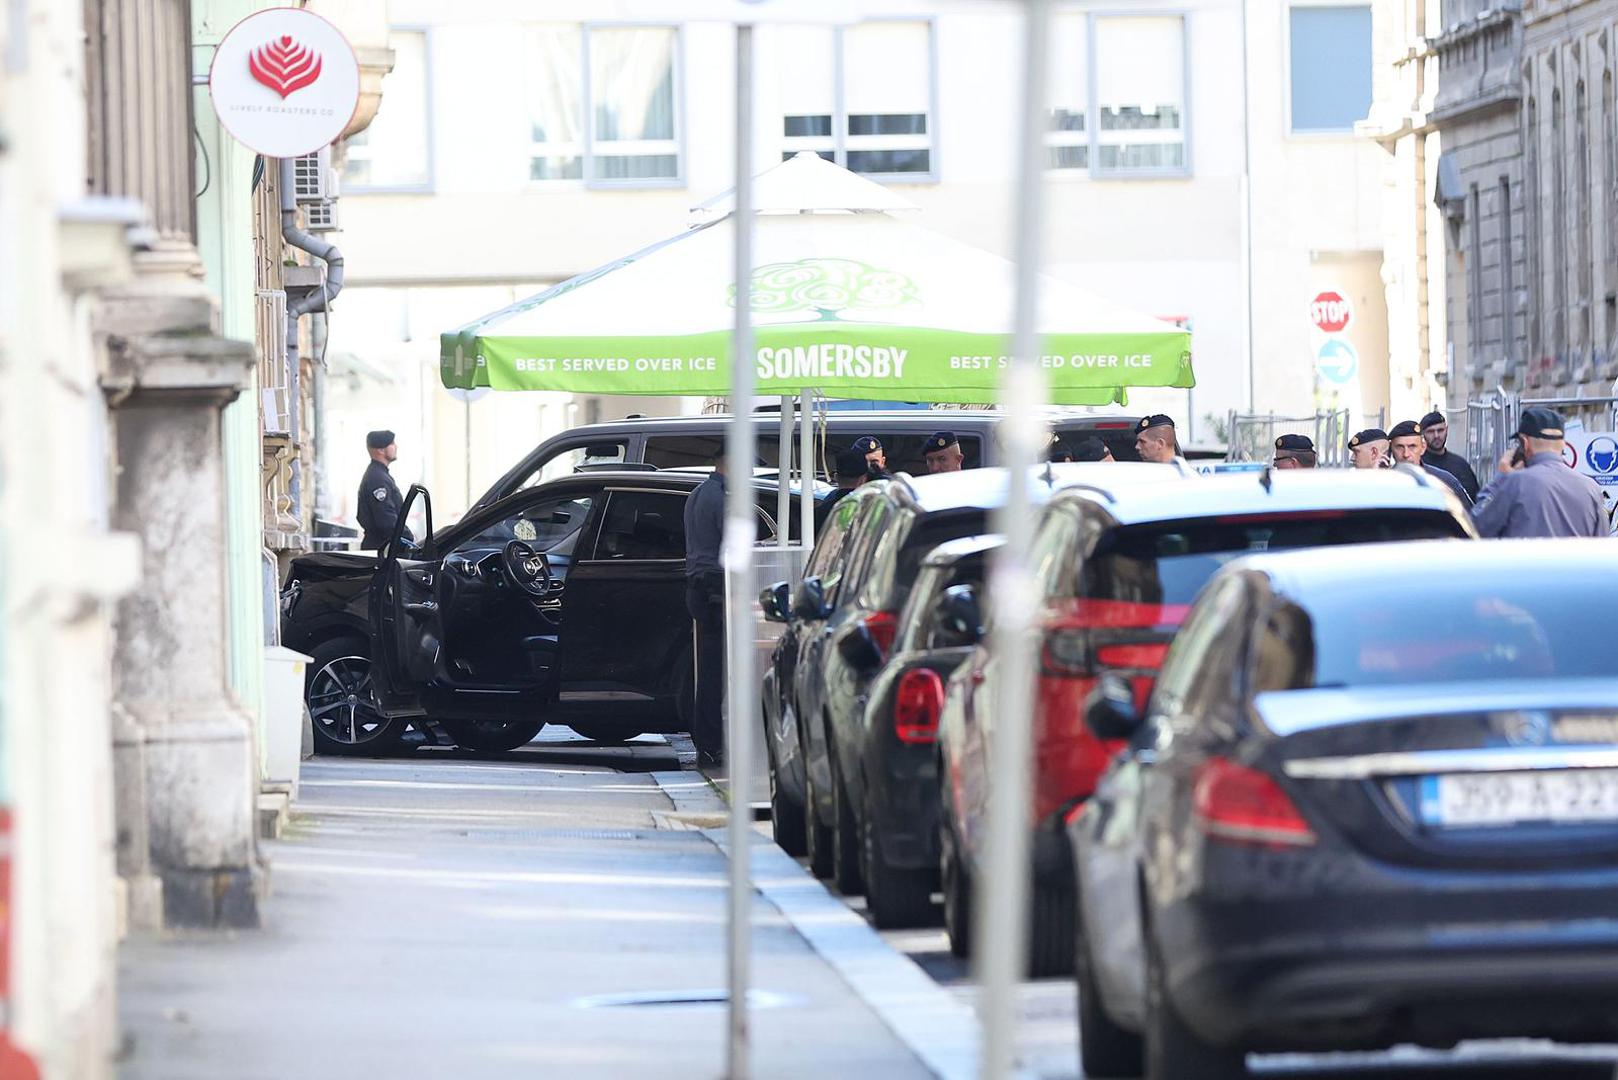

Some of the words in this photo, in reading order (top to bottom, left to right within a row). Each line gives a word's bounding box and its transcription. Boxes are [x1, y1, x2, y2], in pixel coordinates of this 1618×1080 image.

[230, 104, 262, 112] LIVELY
[265, 106, 317, 115] ROASTERS
[1311, 300, 1349, 324] STOP
[515, 358, 556, 371] BEST
[562, 358, 629, 371] SERVED
[635, 358, 683, 371] OVER
[689, 358, 716, 370] ICE
[757, 344, 908, 379] SOMERSBY
[950, 356, 992, 369] BEST
[1071, 355, 1118, 368] OVER
[1124, 354, 1152, 367] ICE
